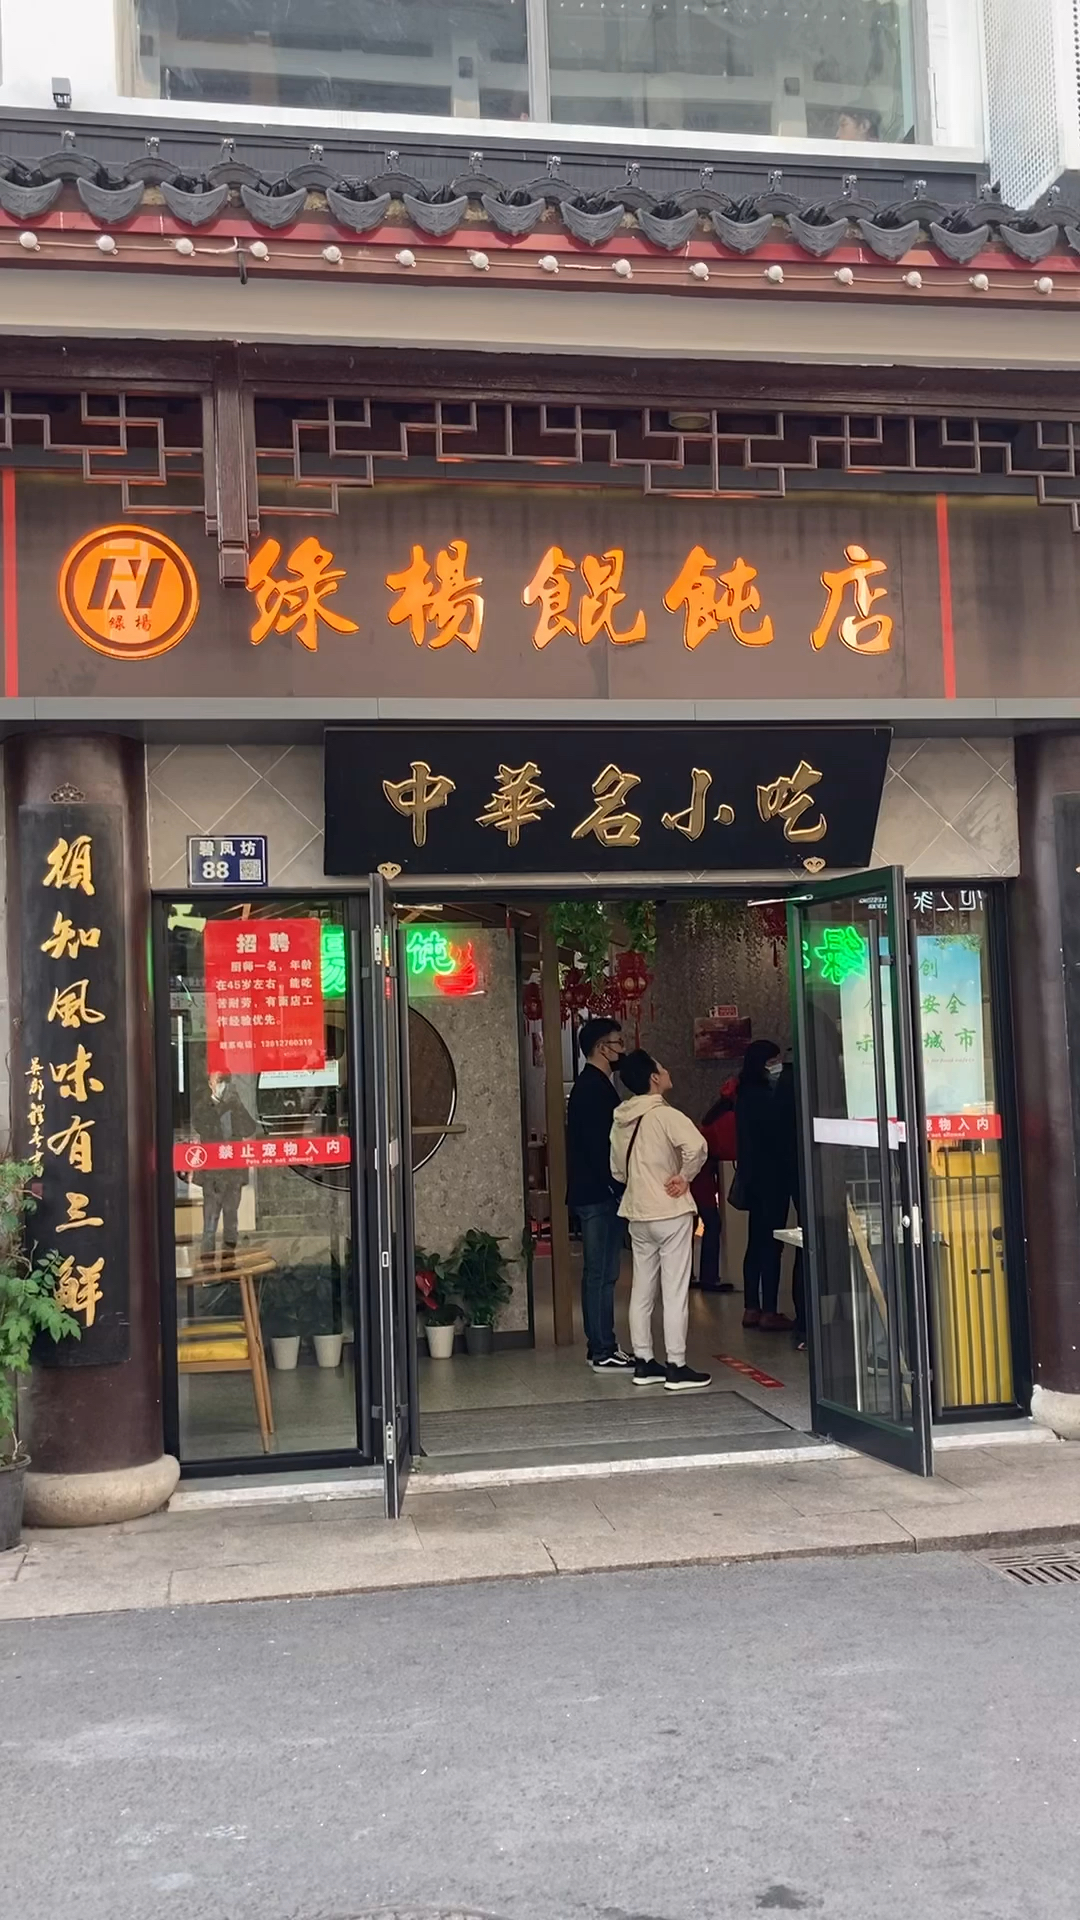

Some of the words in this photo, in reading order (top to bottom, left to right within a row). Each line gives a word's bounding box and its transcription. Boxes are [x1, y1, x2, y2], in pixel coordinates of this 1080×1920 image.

[382, 760, 828, 847] 中華名小吃
[199, 840, 256, 857] 碧凤坊
[202, 861, 230, 879] 88
[236, 932, 290, 954] 招聘
[218, 1140, 340, 1160] 禁止宠物入内
